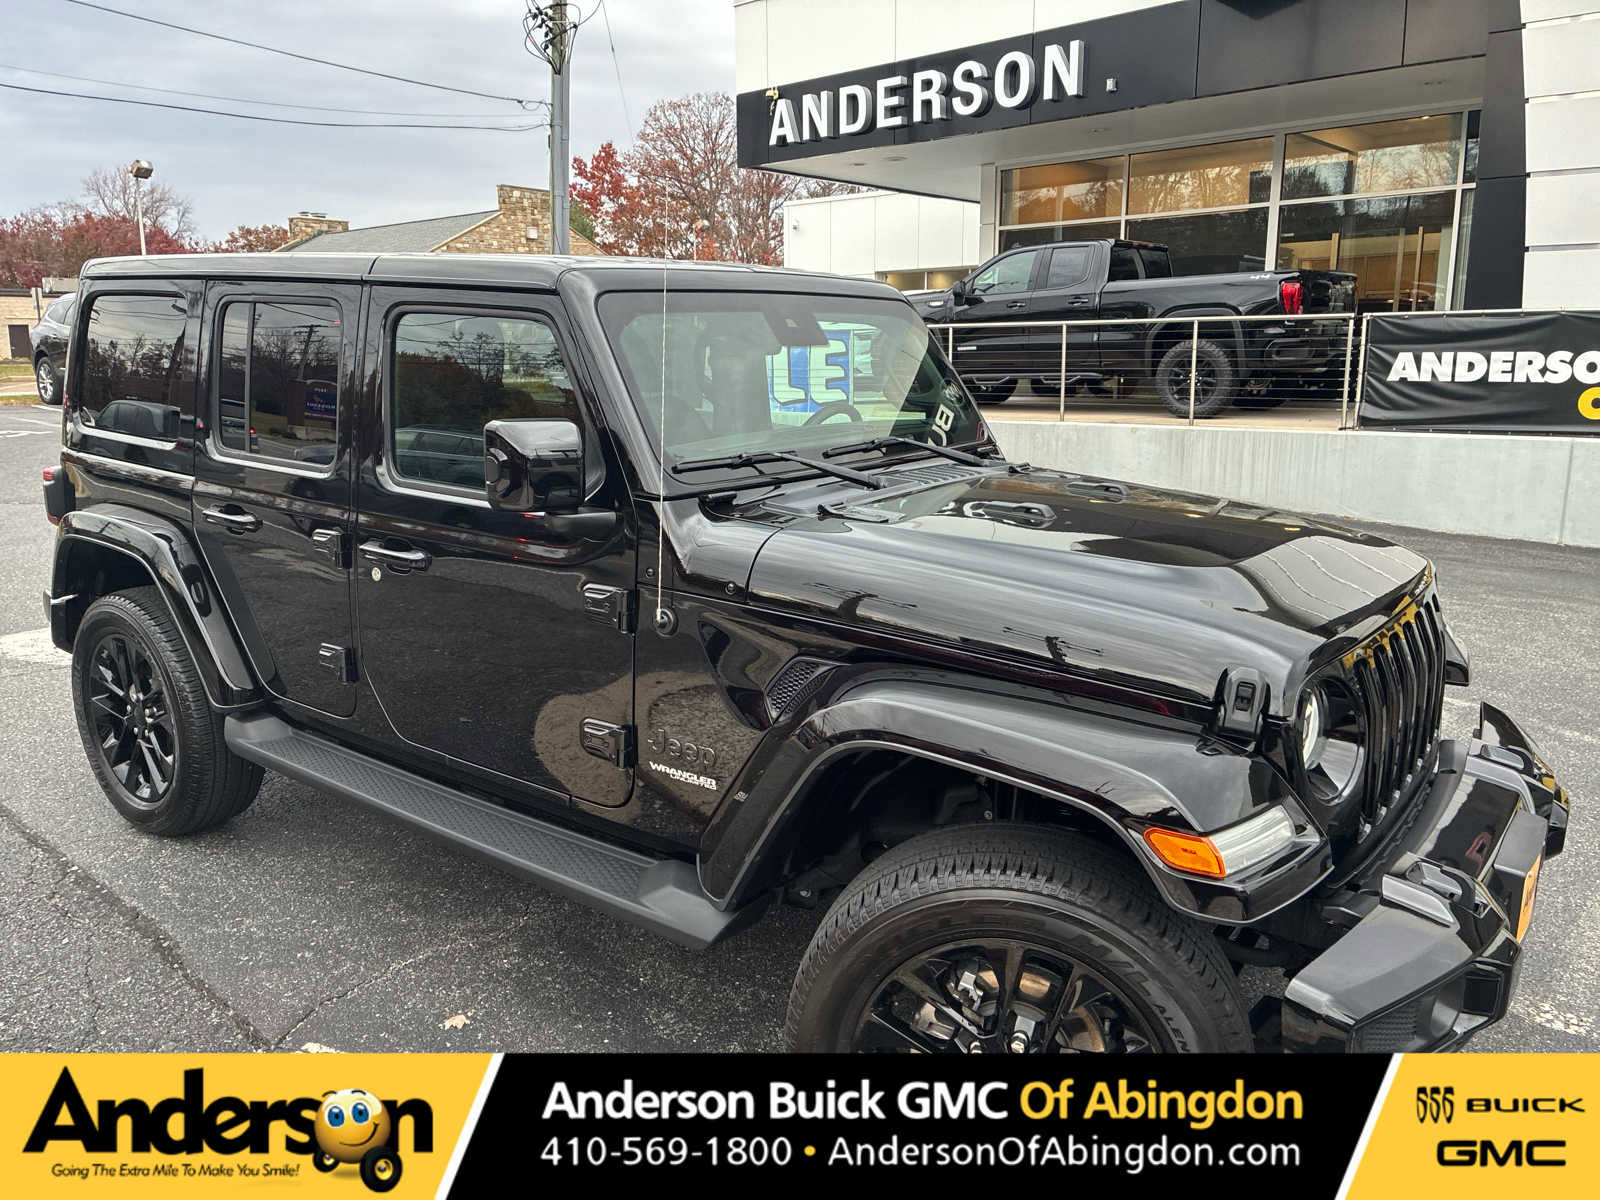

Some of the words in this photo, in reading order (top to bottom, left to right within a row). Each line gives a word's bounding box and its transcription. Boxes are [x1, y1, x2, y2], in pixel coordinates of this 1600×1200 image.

[769, 39, 1084, 146] ANDERSON
[1386, 351, 1600, 384] ANDERSO
[647, 728, 717, 772] Jeep
[649, 761, 717, 786] WRANGLER
